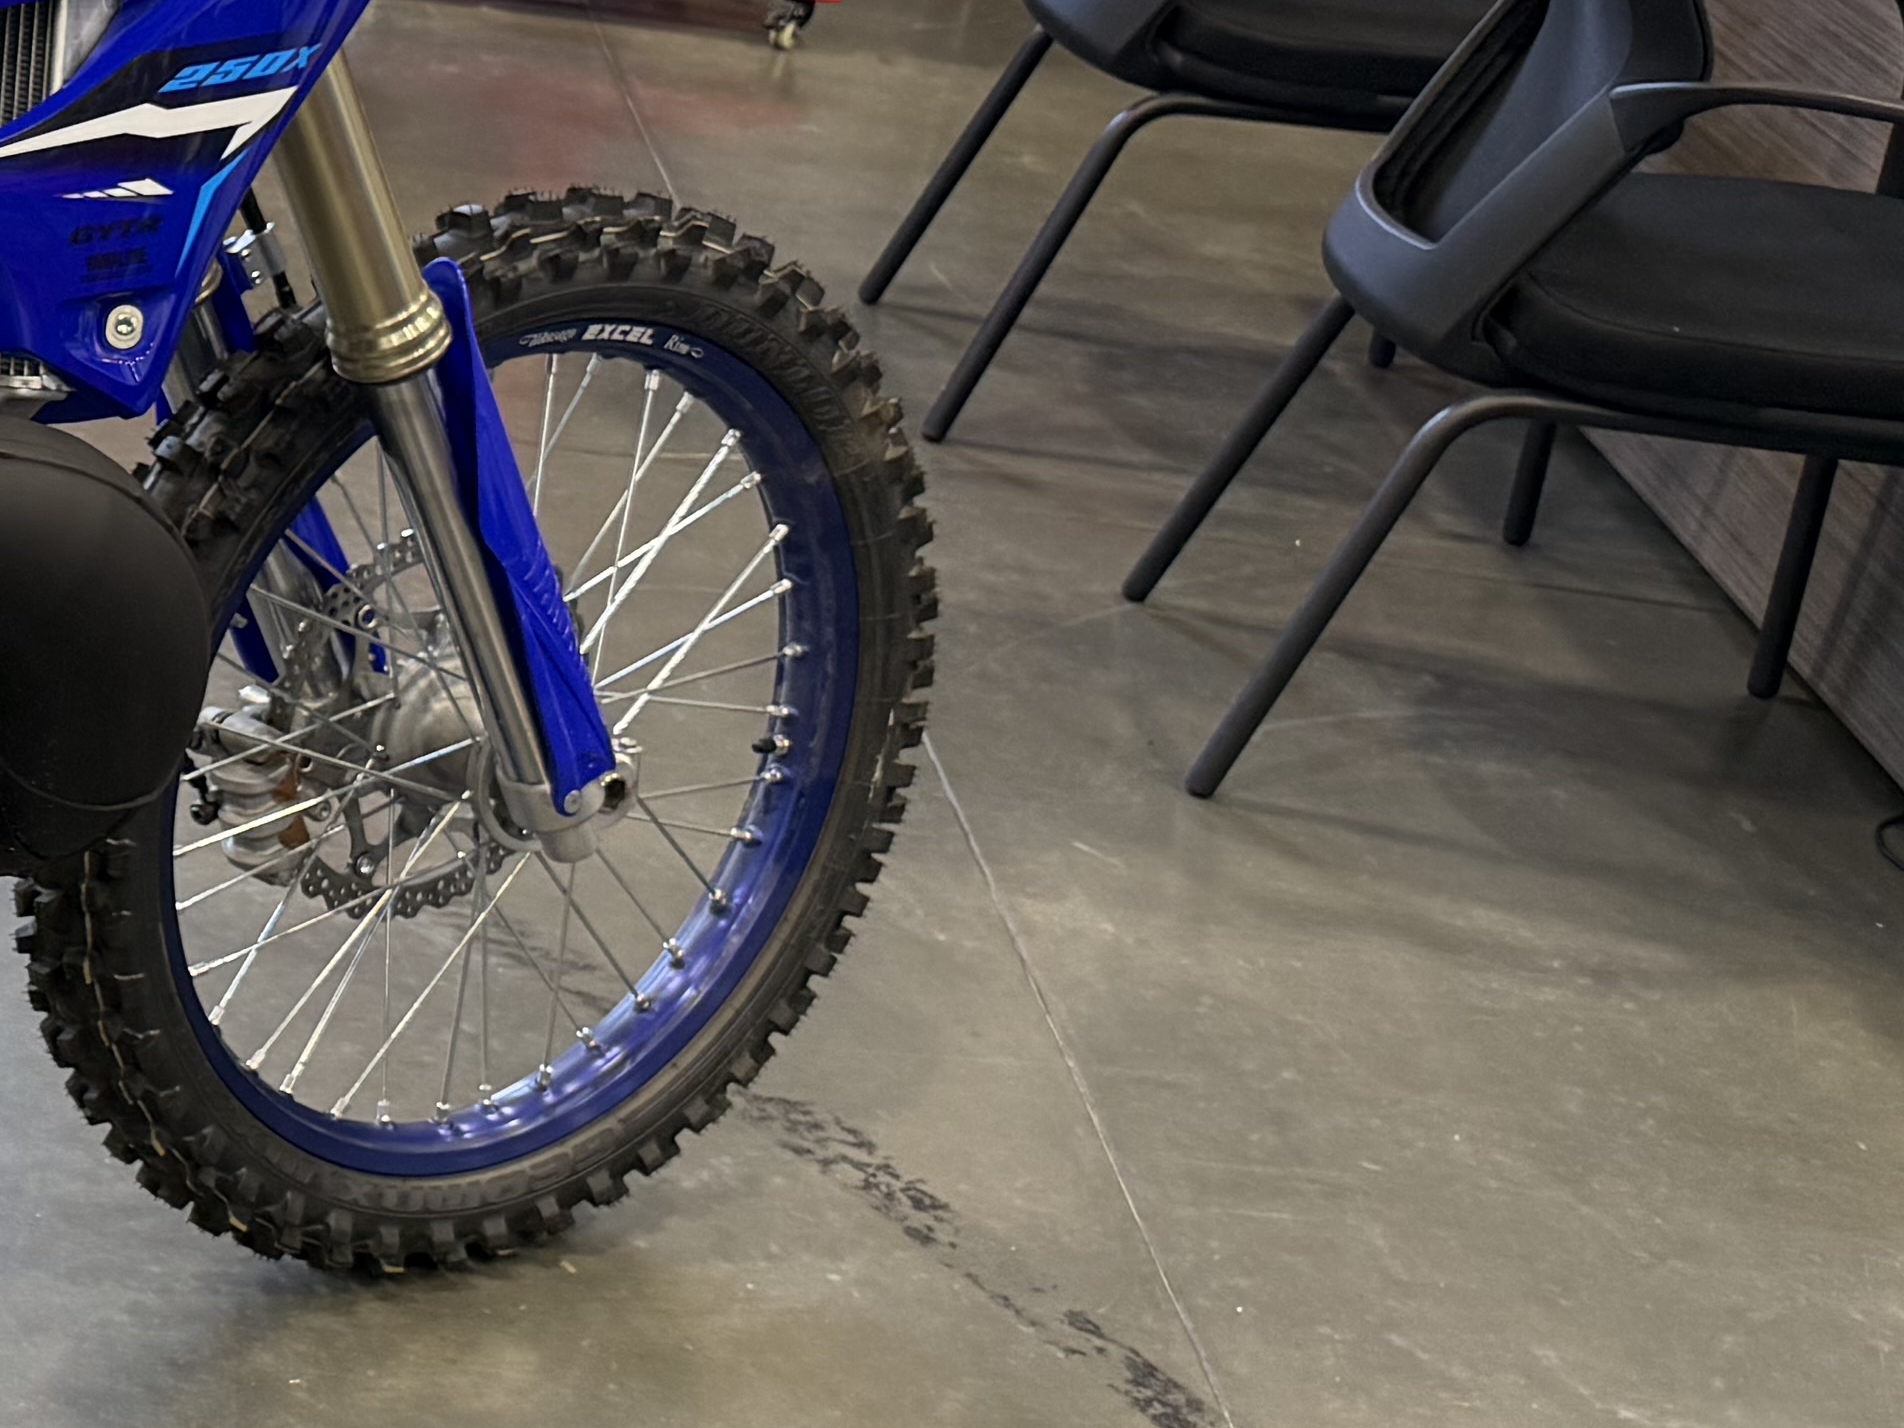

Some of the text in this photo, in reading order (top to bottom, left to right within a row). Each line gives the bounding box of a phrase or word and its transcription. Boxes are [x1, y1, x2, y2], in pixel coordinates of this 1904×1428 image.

[158, 43, 323, 93] 250X
[581, 323, 654, 346] EXCEL
[664, 334, 705, 359] Rim
